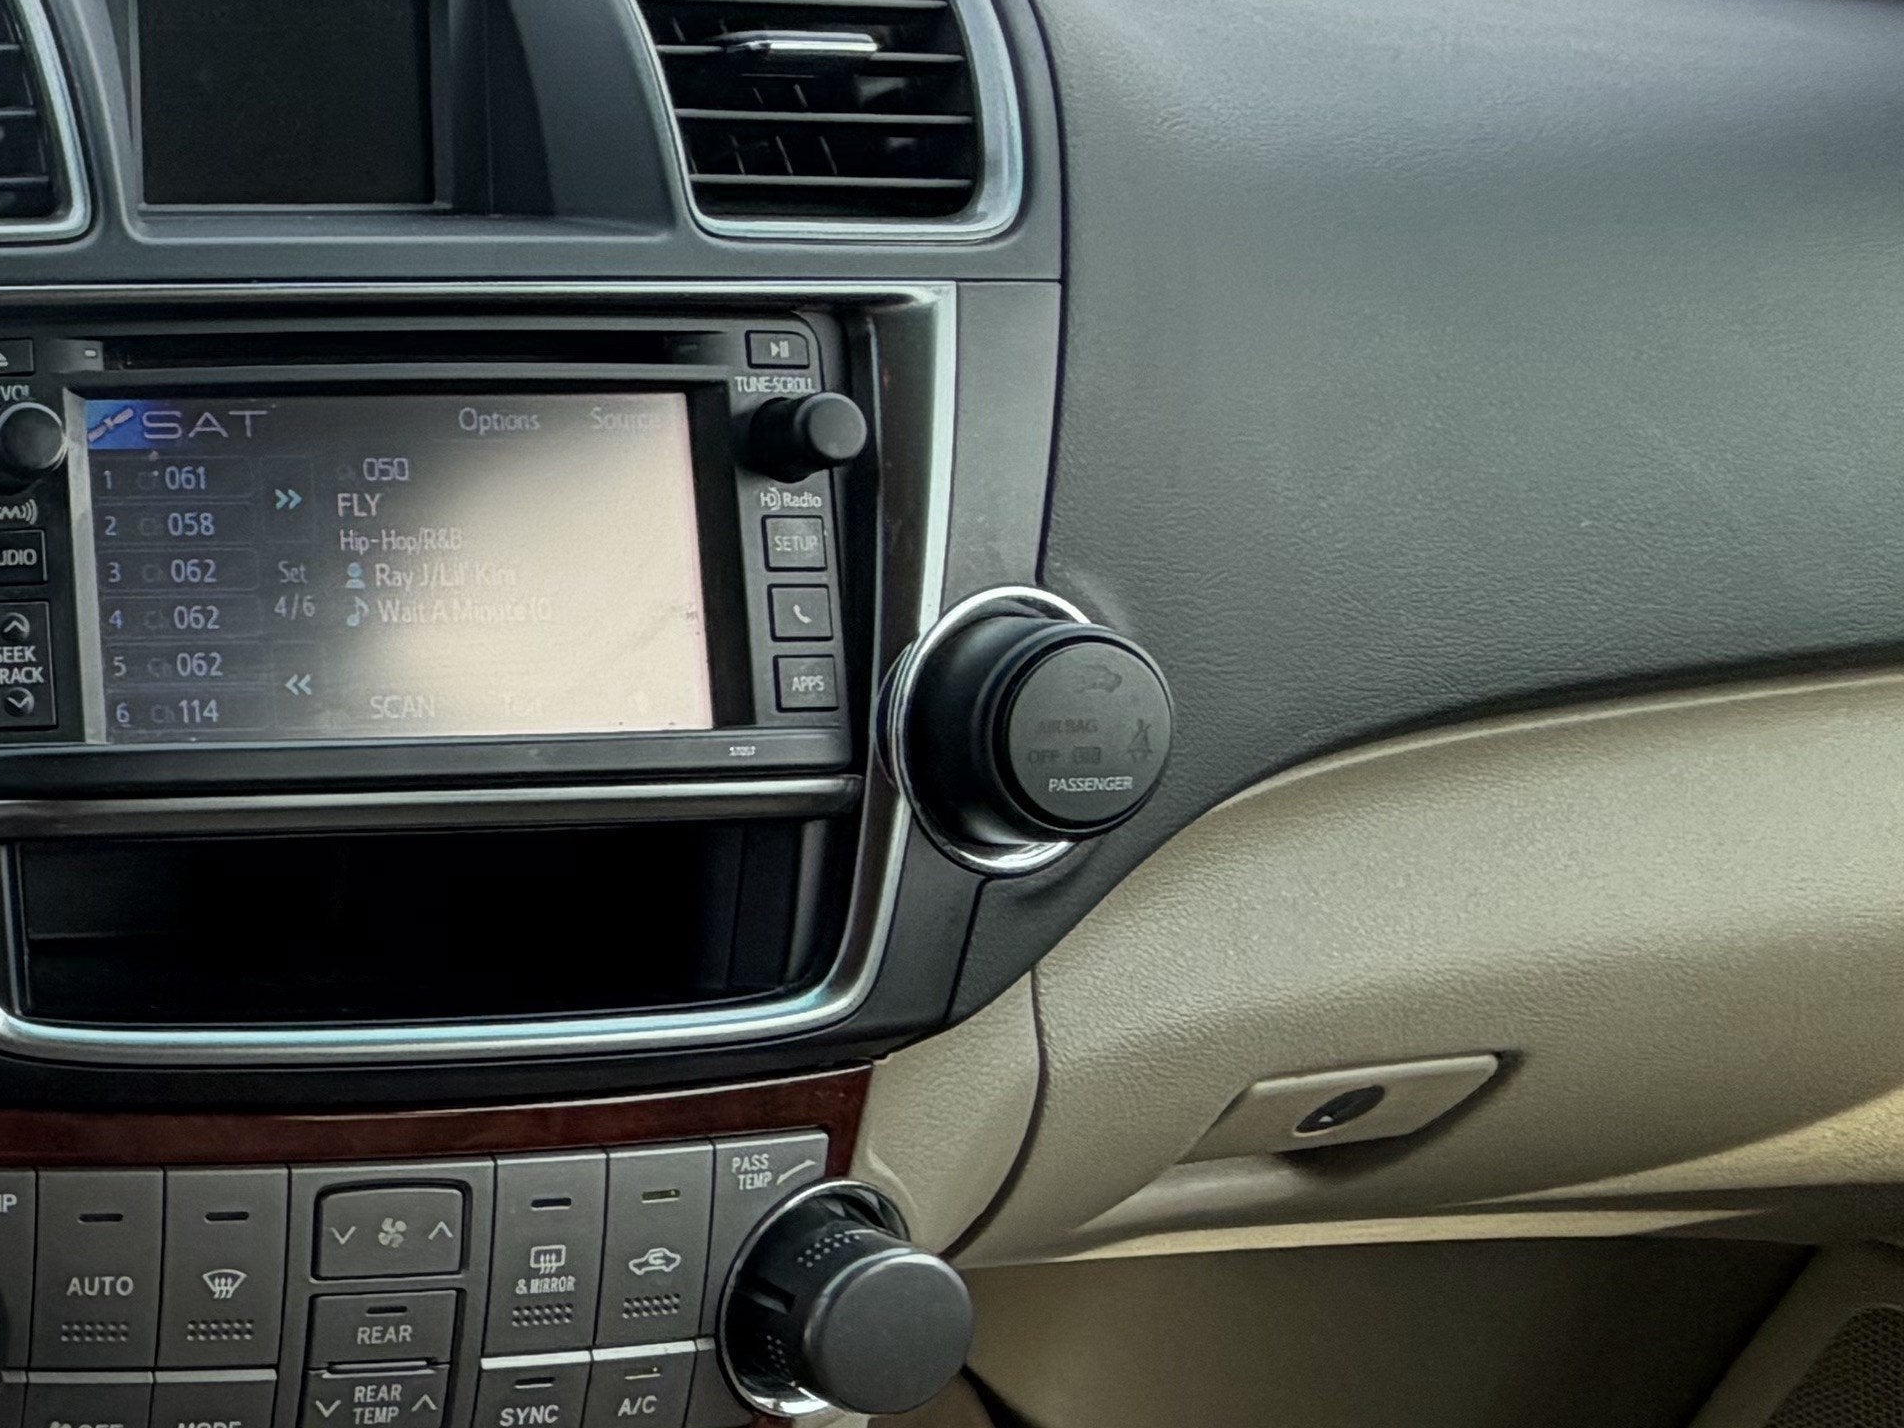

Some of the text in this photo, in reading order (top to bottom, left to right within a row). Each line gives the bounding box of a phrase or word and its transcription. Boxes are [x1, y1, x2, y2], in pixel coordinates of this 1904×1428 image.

[142, 410, 268, 439] SAT
[458, 407, 540, 436] Options
[103, 469, 113, 490] 1
[165, 466, 207, 490] 061
[362, 457, 410, 482] 050
[337, 492, 382, 518] FLY
[104, 516, 117, 537] 2
[167, 513, 215, 537] 058
[107, 562, 122, 583] 3
[170, 559, 218, 583] 062
[277, 561, 306, 585] Set
[375, 563, 414, 592] Ray
[109, 609, 123, 630] 4
[173, 605, 221, 630] 062
[113, 656, 127, 677] 5
[176, 652, 224, 677] 062
[792, 675, 825, 693] APPS
[116, 702, 130, 722] 6
[179, 699, 219, 724] 114
[371, 695, 435, 719] SCAN
[1048, 776, 1133, 793] PASSENGER
[732, 1154, 770, 1173] PASS
[737, 1173, 773, 1191] TEMP
[66, 1276, 135, 1297] AUTO
[529, 1275, 576, 1295] MIRROR
[356, 1325, 413, 1345] REAR
[353, 1385, 403, 1404] REAR
[618, 1395, 658, 1417] A/C
[352, 1407, 400, 1427] TEMP
[499, 1405, 560, 1428] SYNC
